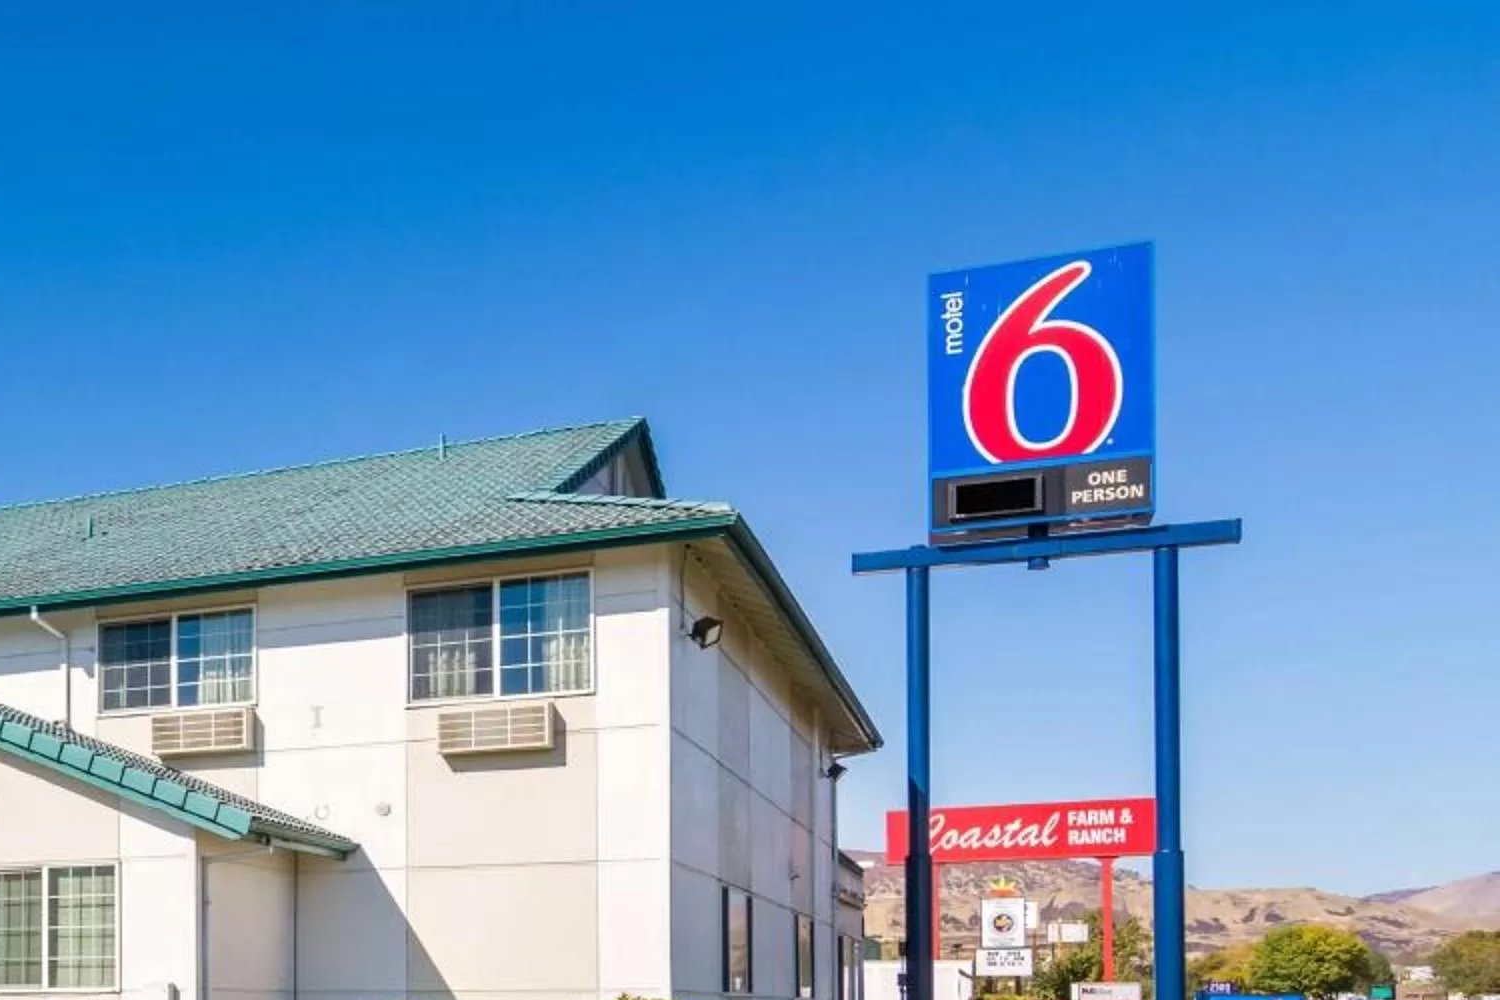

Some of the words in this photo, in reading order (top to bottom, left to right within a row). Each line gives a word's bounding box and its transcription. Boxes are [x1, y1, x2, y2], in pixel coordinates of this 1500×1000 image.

[940, 291, 963, 354] motel
[962, 260, 1123, 464] 6
[1087, 468, 1129, 486] ONE
[1071, 483, 1145, 505] PERSON
[1067, 808, 1115, 827] FARM
[1120, 806, 1134, 825] &
[1067, 827, 1127, 846] RANCH
